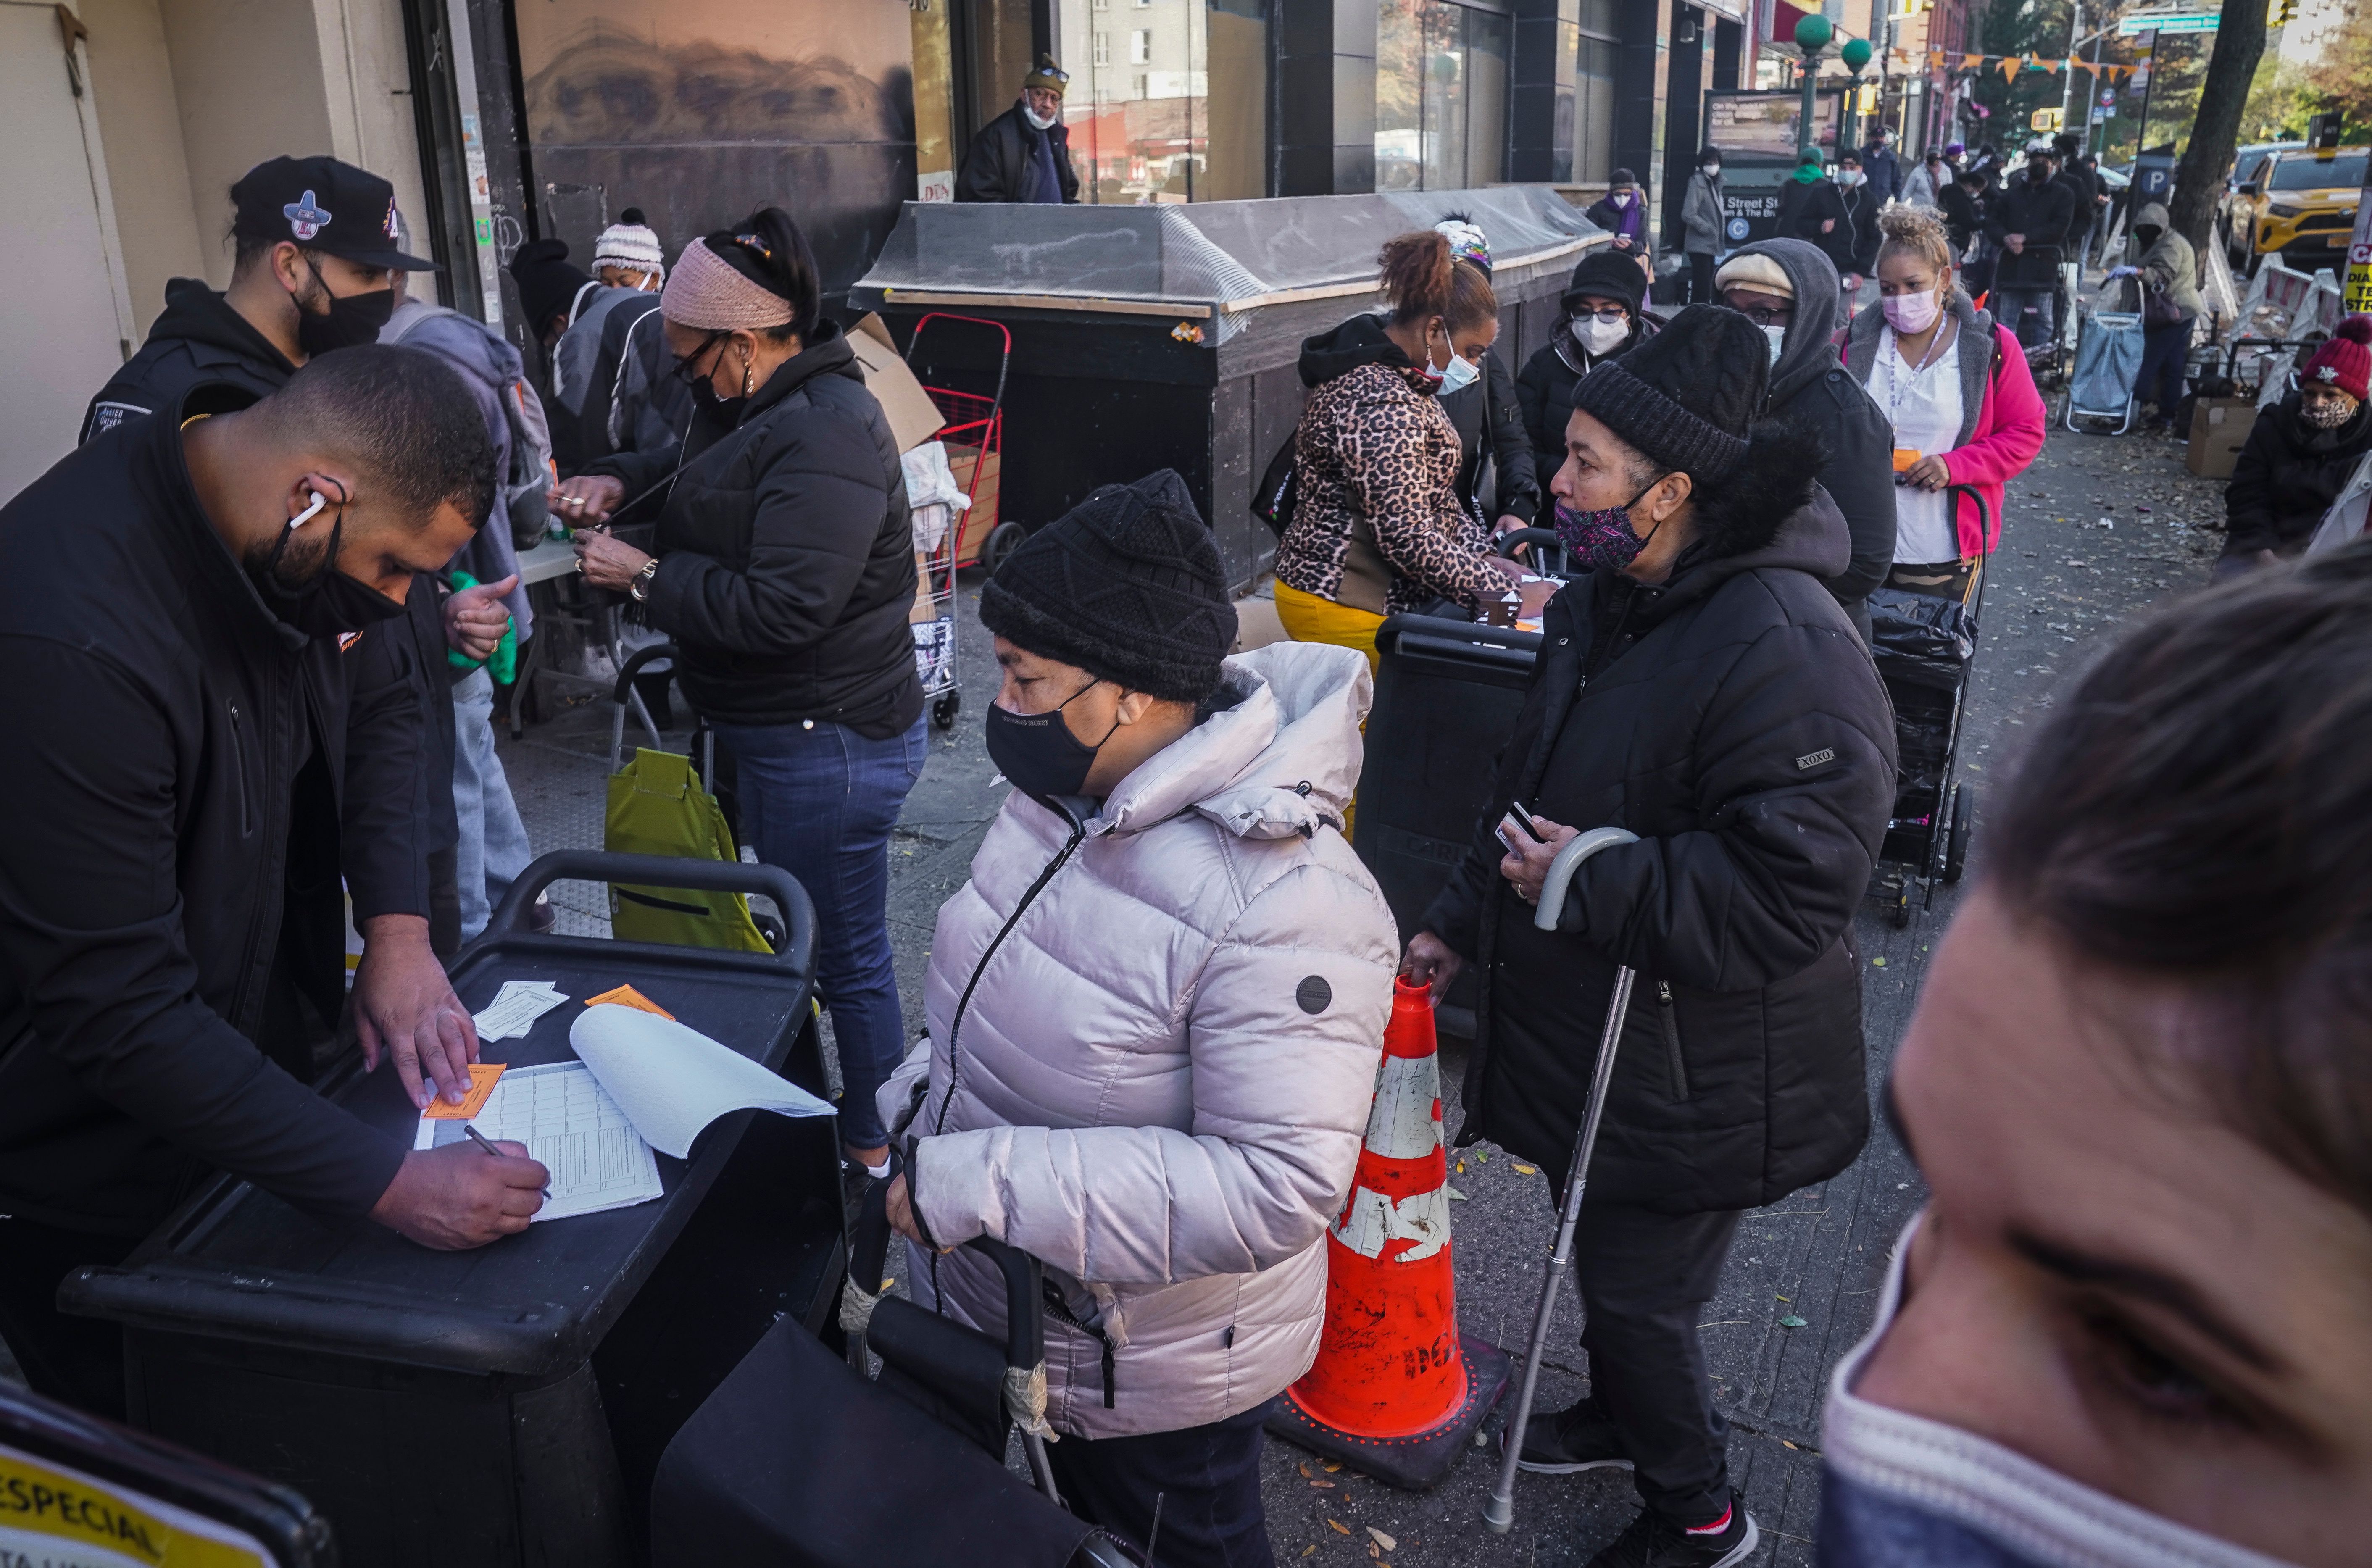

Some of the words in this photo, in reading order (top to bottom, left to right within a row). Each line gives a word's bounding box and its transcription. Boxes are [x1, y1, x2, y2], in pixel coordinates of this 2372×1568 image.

[2150, 171, 2164, 191] P
[1727, 197, 1762, 209] Street
[1766, 197, 1779, 209] St
[1732, 222, 1744, 235] C
[2348, 273, 2372, 282] DIA
[2356, 287, 2372, 297] TE
[2346, 299, 2372, 310] STR
[103, 407, 123, 418] ALLIED
[1801, 750, 1830, 767] XOXO
